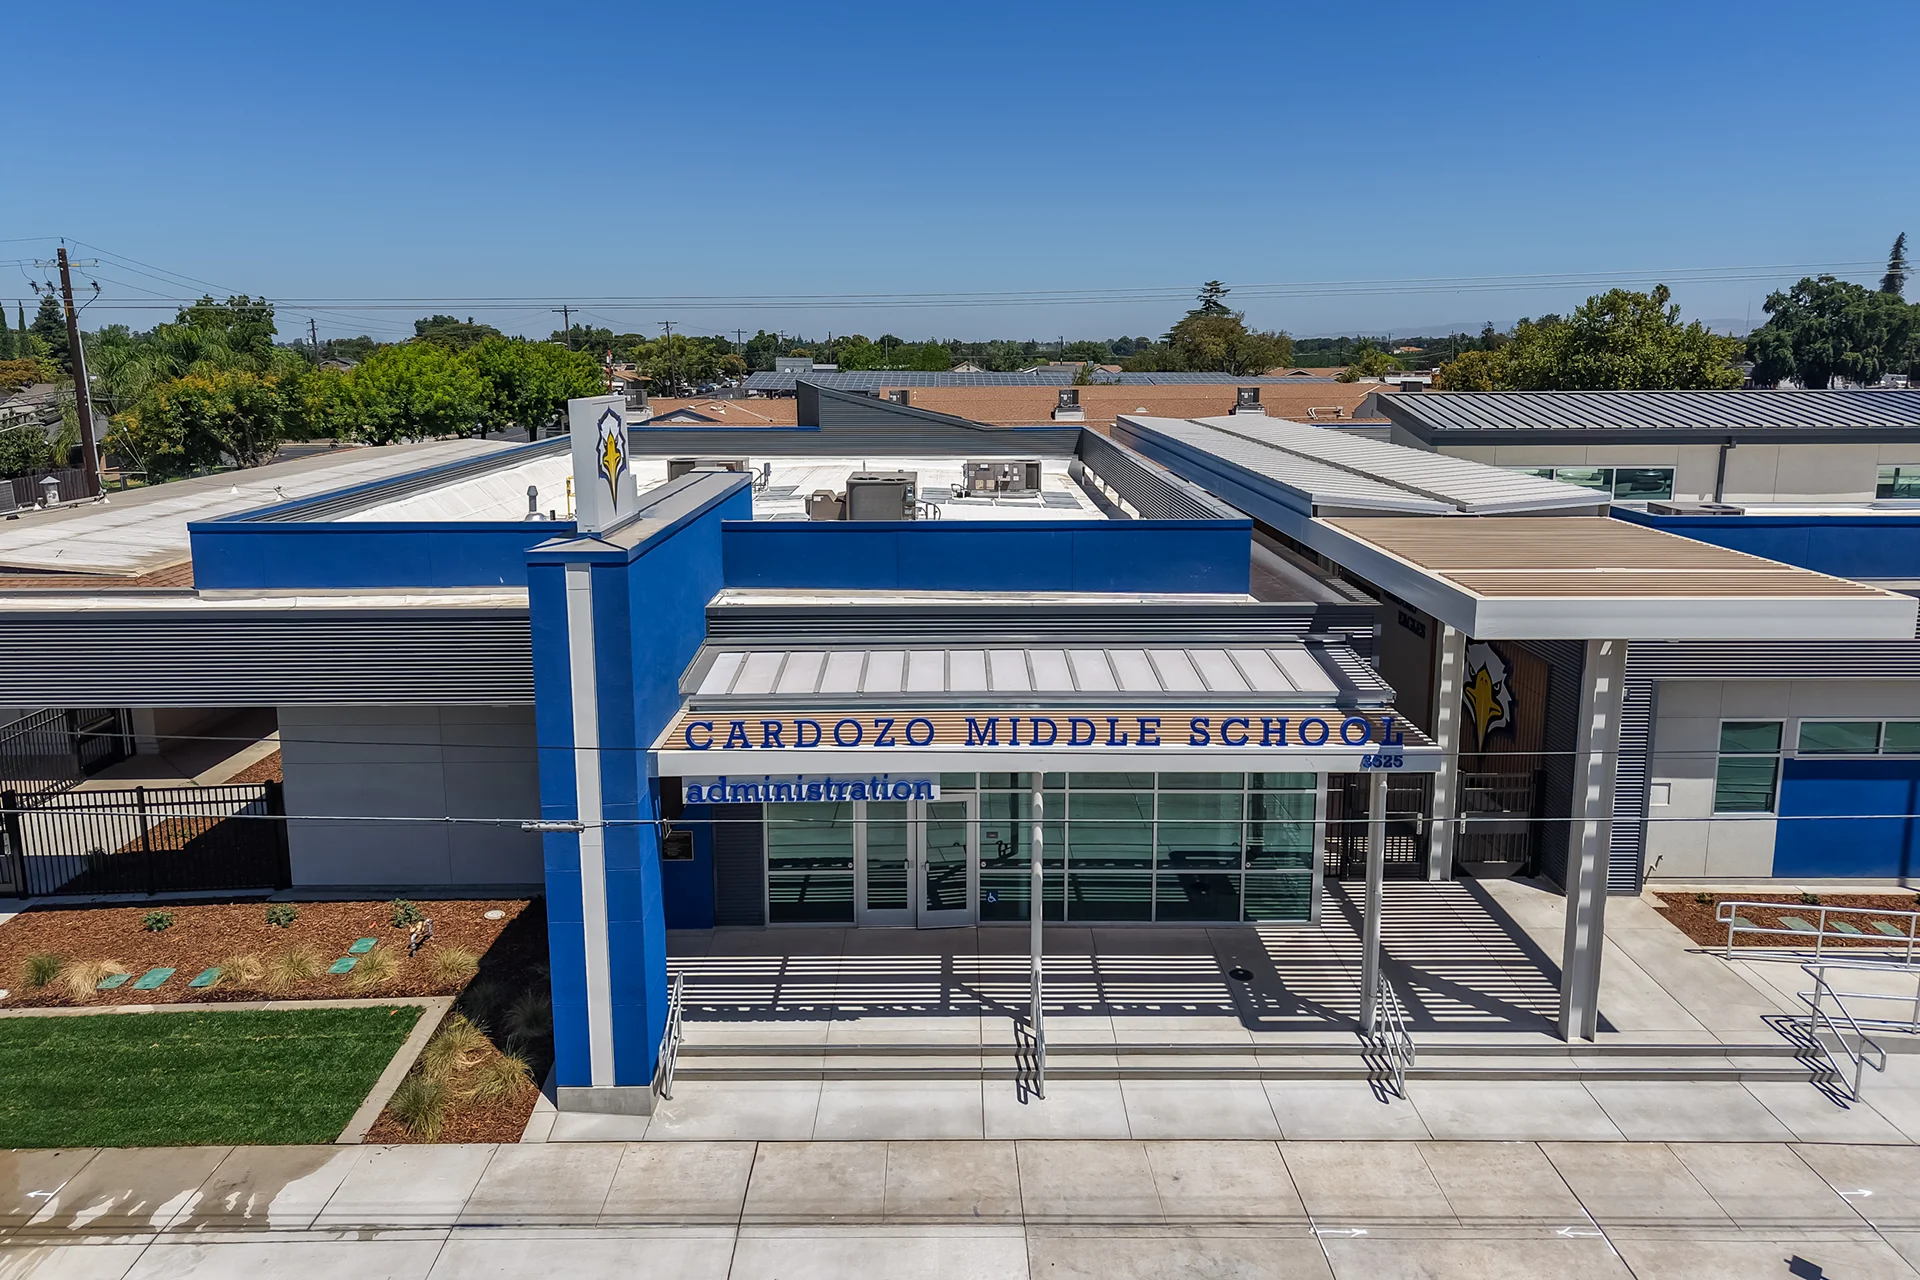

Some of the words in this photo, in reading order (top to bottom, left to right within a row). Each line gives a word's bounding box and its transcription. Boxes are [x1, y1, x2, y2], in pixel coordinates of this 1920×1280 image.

[685, 718, 935, 750] CARDOZO
[965, 717, 1161, 746] MIDDLE
[1190, 717, 1403, 746] SCHOOL
[686, 774, 935, 804] administration
